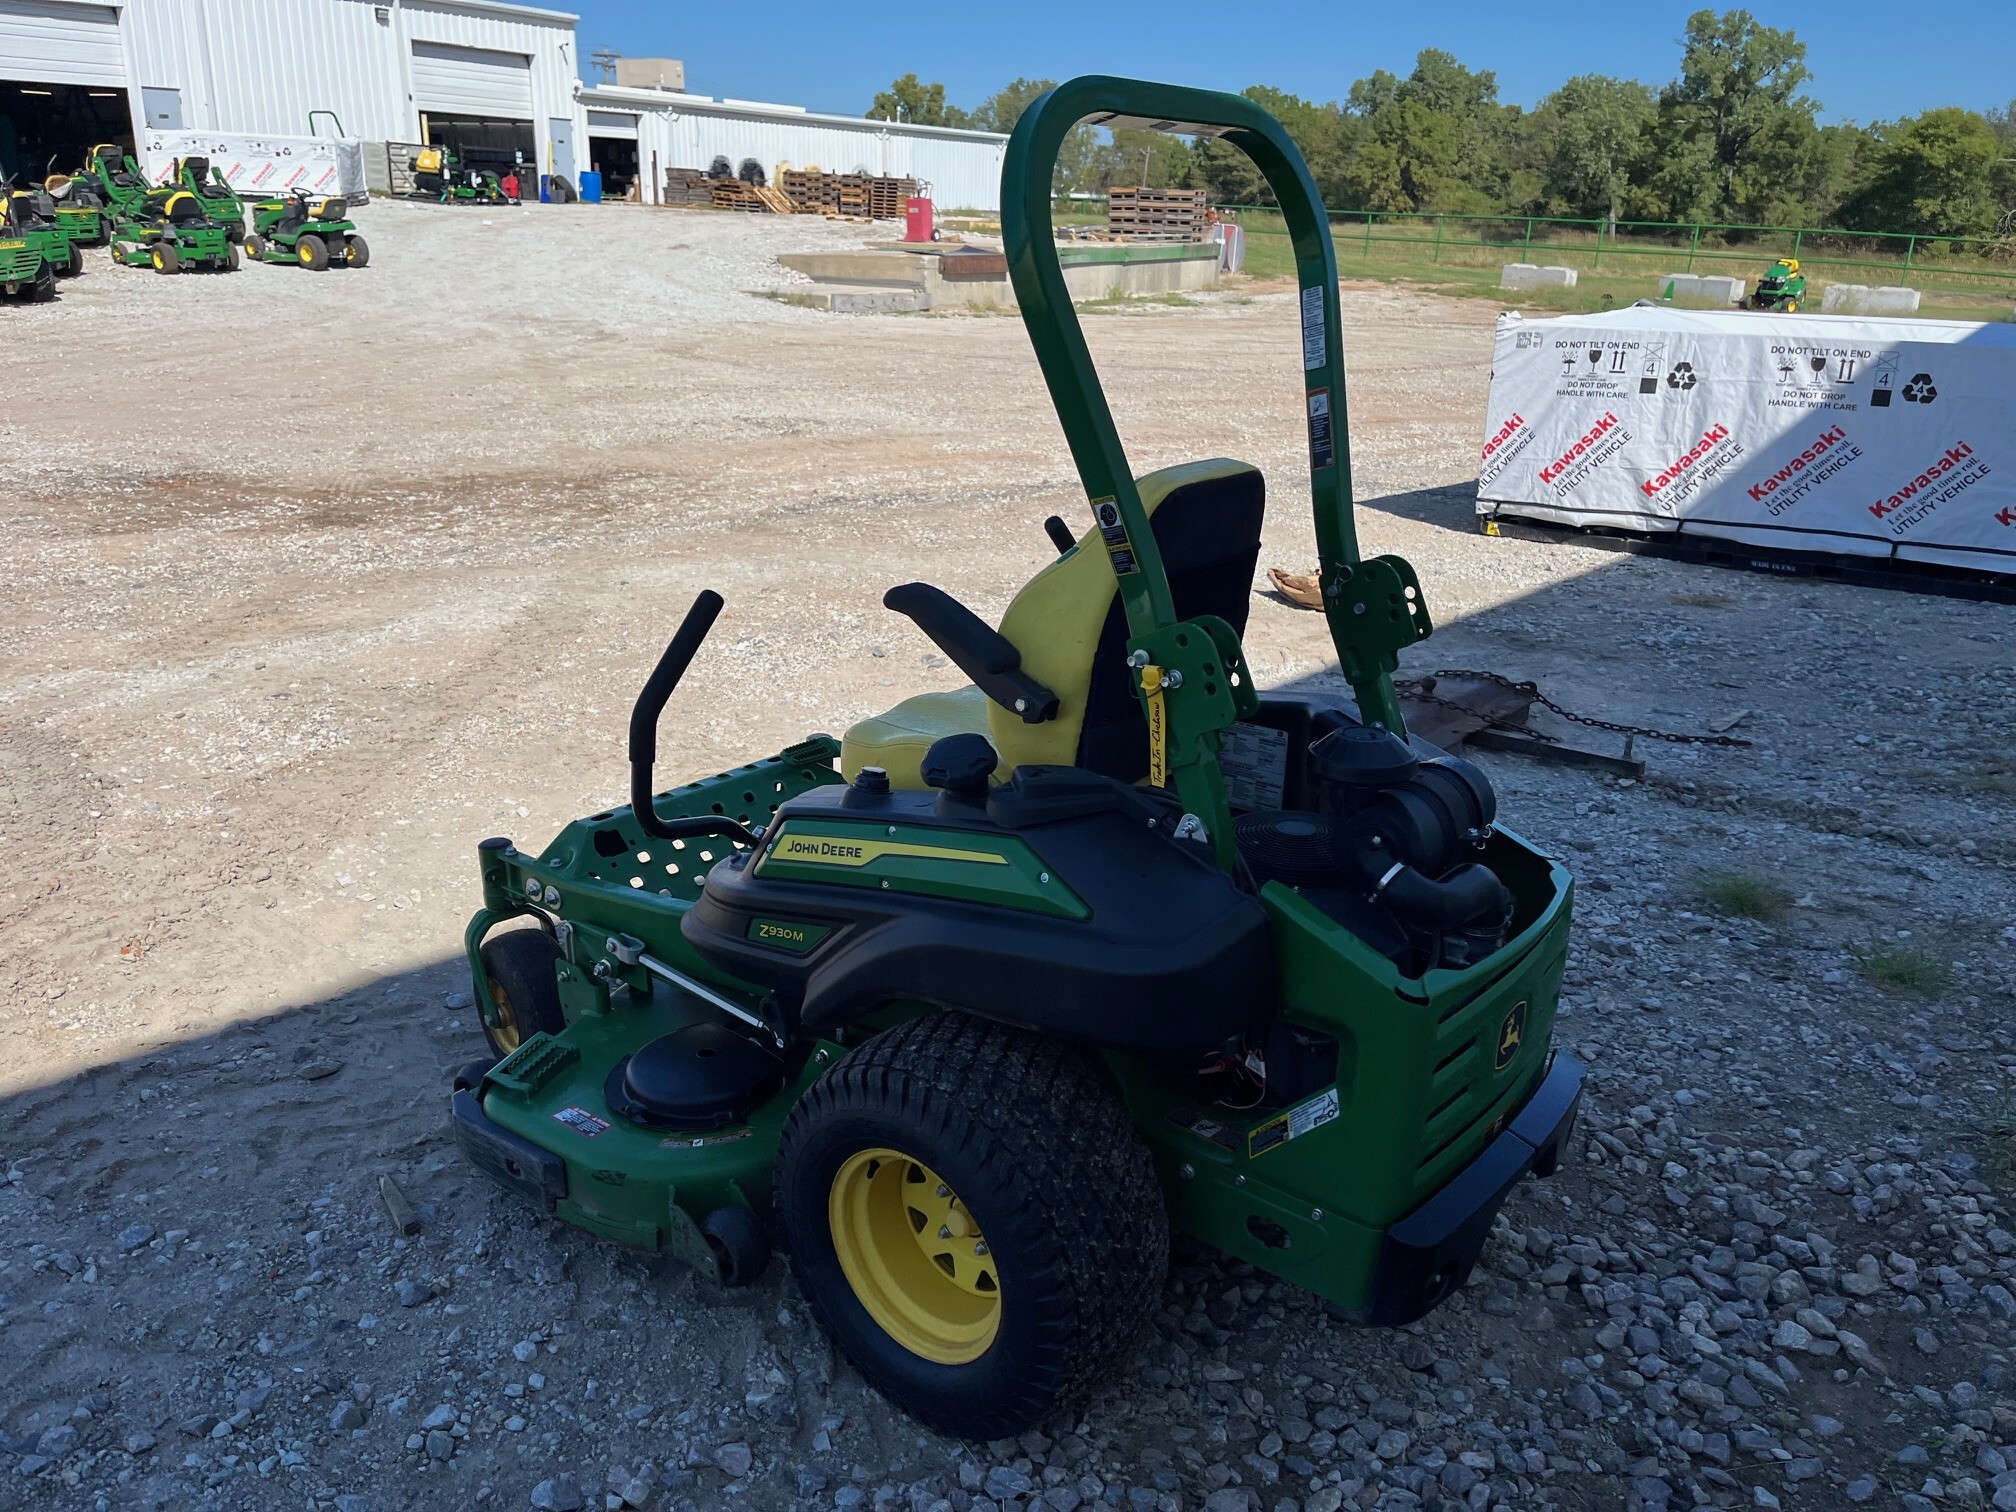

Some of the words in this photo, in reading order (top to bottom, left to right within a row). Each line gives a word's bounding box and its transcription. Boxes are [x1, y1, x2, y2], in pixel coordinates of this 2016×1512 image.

[1569, 341, 1587, 349] NOT
[1589, 341, 1606, 349] TILT
[1607, 341, 1620, 349] ON
[1621, 342, 1640, 350] END
[1646, 363, 1655, 375] 4
[1770, 346, 1785, 354] DO
[1787, 347, 1809, 355] NOT
[1811, 347, 1830, 356] TILT
[1832, 349, 1848, 357] ON
[1850, 350, 1871, 359] END
[1768, 399, 1805, 408] HANDLE
[1807, 401, 1831, 409] WITH
[1833, 403, 1858, 411] CARE
[1783, 390, 1797, 398] DO
[1799, 391, 1818, 399] NOT
[1820, 392, 1846, 400] DROP
[1878, 373, 1889, 386] 4
[1478, 464, 1502, 490] TILITY
[1500, 431, 1536, 466] VEHICLE
[1538, 411, 1619, 484] Kawasaki
[1553, 477, 1565, 489] Let
[1564, 468, 1577, 479] the
[1575, 453, 1592, 470] good
[1590, 439, 1610, 455] times
[1556, 465, 1590, 497] UTILITY
[1589, 431, 1633, 468] VEHICLE
[1640, 423, 1729, 498] Kawasaki
[1746, 424, 1847, 502] Kawasaki
[1656, 490, 1671, 503] Let
[1671, 481, 1683, 493] the
[1682, 466, 1699, 483] good
[1699, 450, 1719, 468] times
[1661, 479, 1699, 512] UTILITY
[1697, 443, 1744, 481] VEHICLE
[1764, 495, 1780, 507] Let
[1779, 484, 1794, 497] the
[1793, 469, 1813, 486] good
[1812, 453, 1835, 471] times
[1768, 482, 1811, 517] UTILITY
[1809, 446, 1864, 485] VEHICLE
[1868, 440, 1974, 520] Kawasaki
[1887, 512, 1904, 525] Let
[1902, 502, 1918, 515] the
[1917, 486, 1939, 505] good
[1937, 470, 1962, 490] times
[1891, 500, 1937, 536] UTILITY
[1935, 463, 1992, 504] VEHICLE
[787, 840, 819, 854] JOHN
[821, 842, 863, 858] DEERE
[760, 924, 804, 942] Z930M
